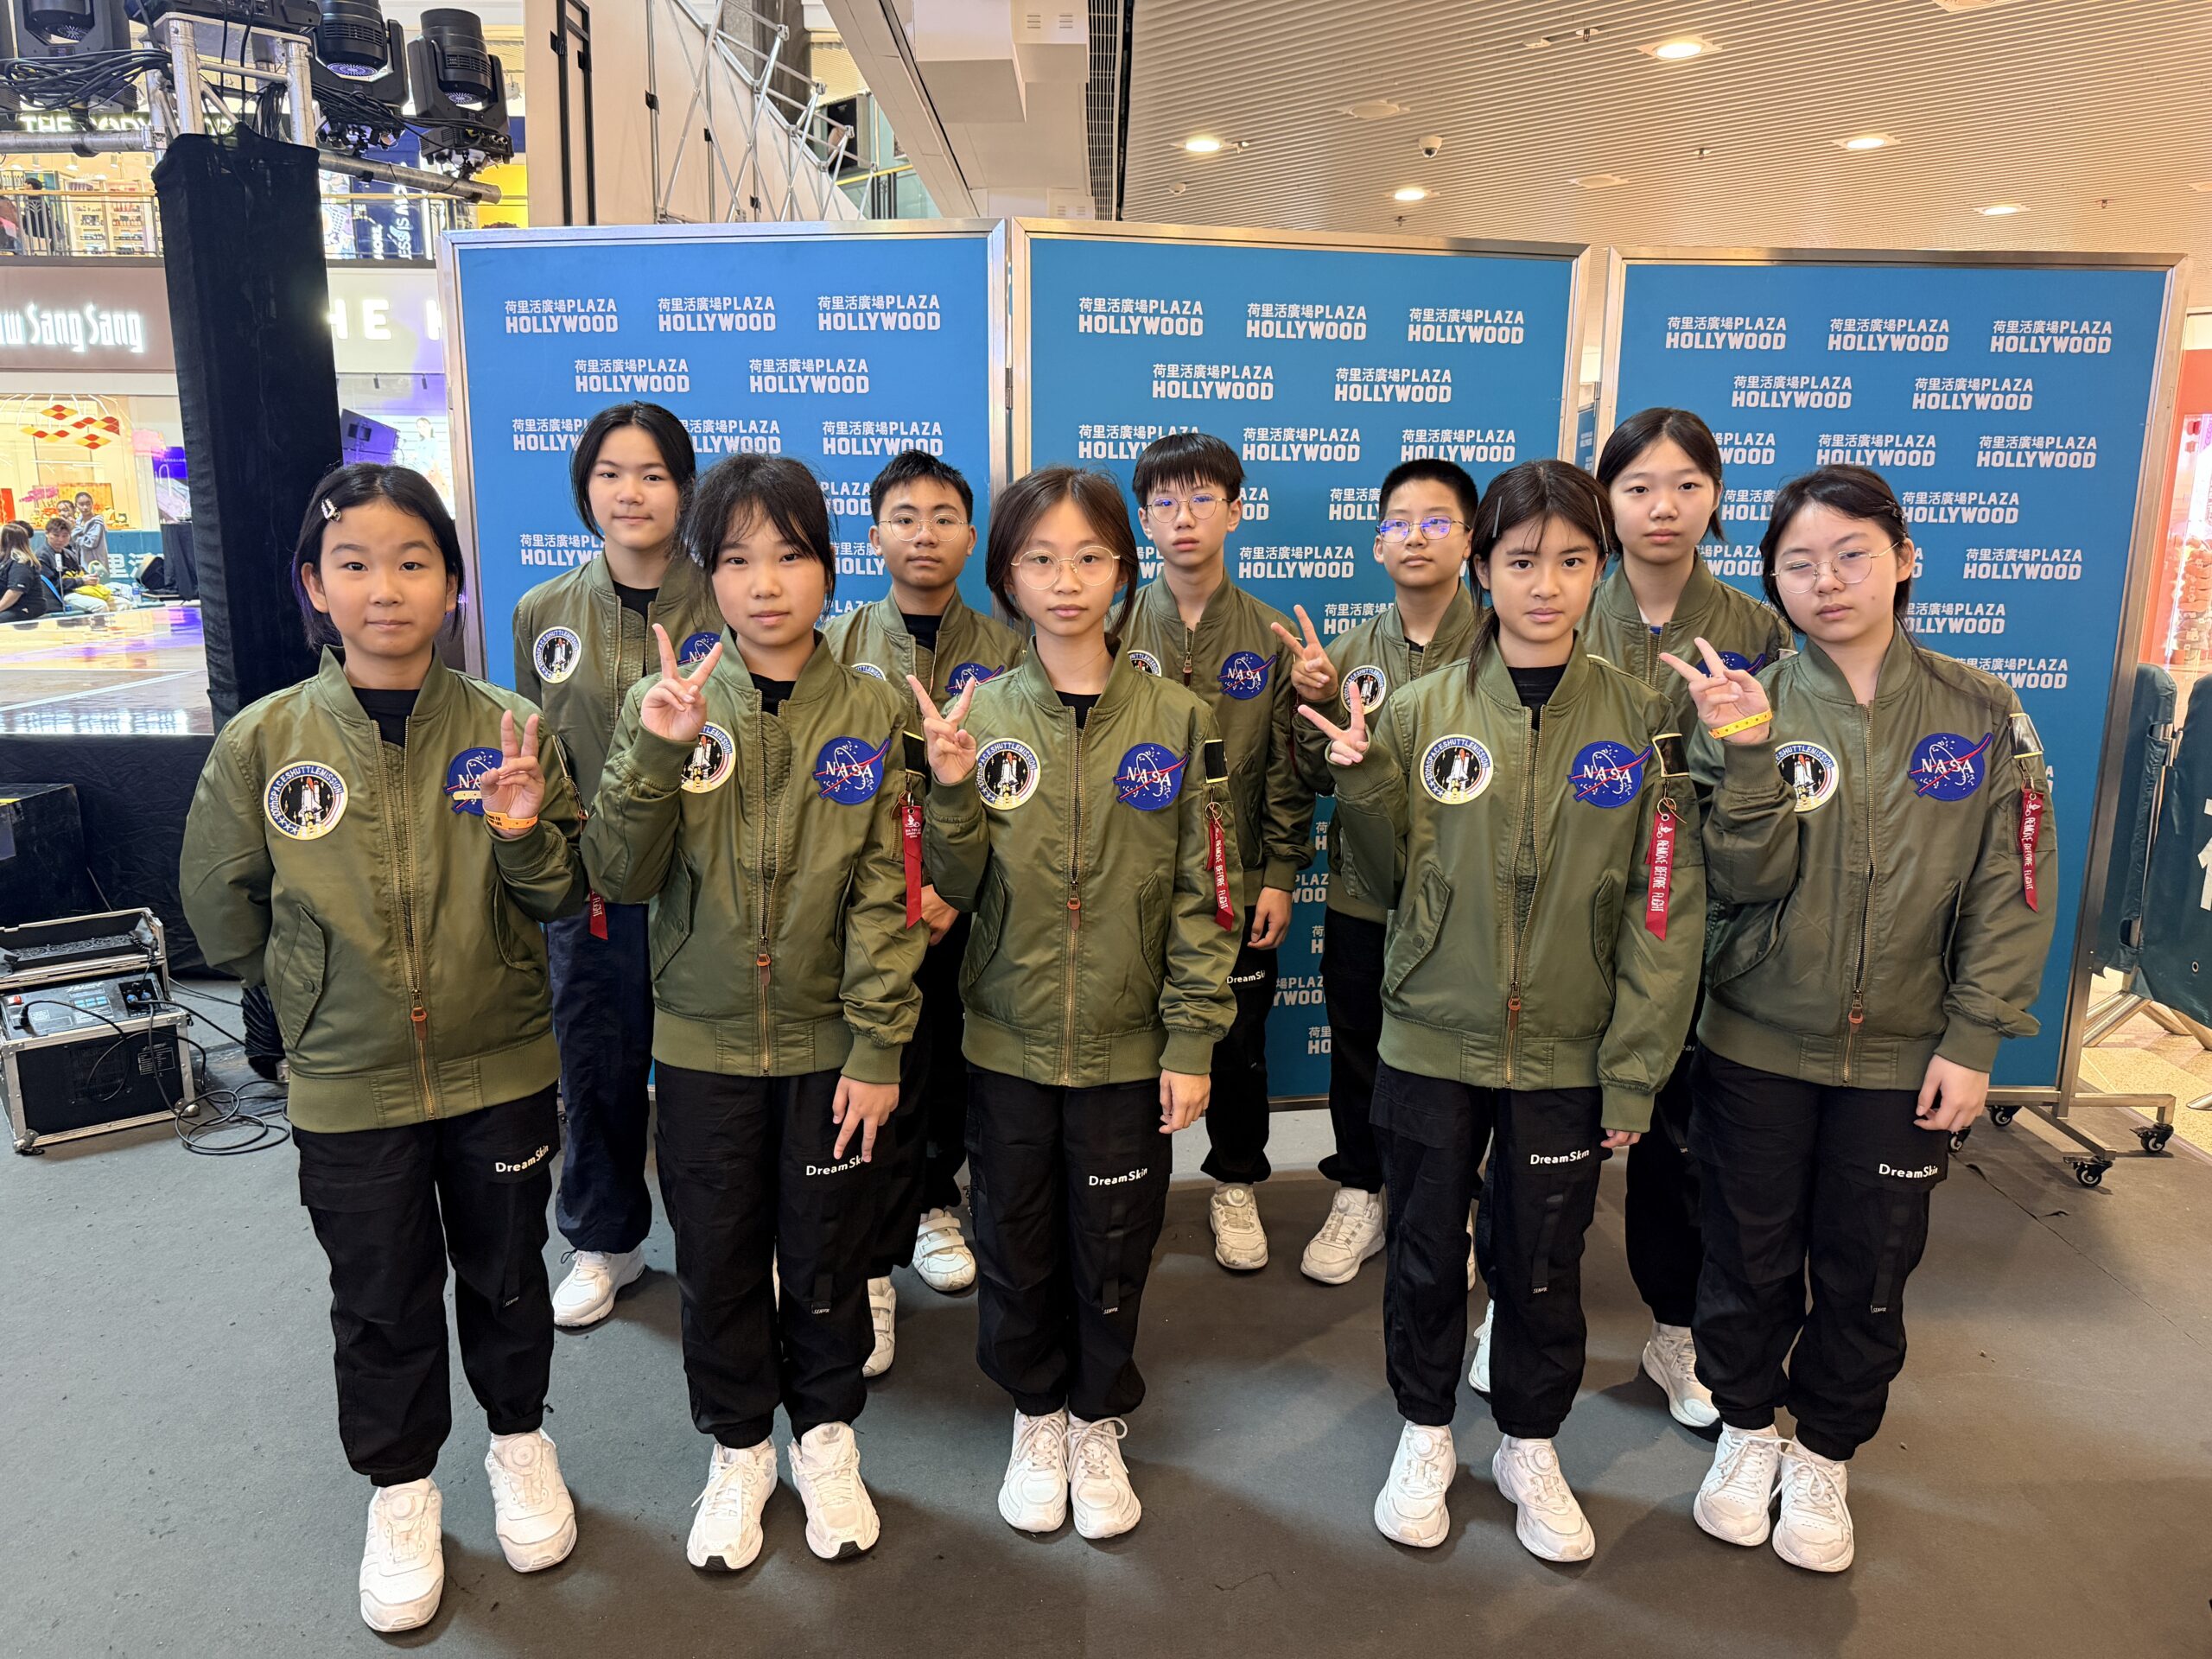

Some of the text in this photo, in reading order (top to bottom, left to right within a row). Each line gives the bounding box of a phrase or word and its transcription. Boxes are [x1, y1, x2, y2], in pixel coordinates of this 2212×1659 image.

[505, 299, 617, 314] 荷里活廣場 PLAZA
[658, 297, 775, 312] 荷里活廣場 PLAZA
[817, 295, 940, 310] 荷里活廣場 PLAZA
[1078, 297, 1203, 315] 荷里活廣場 PLAZA
[1247, 303, 1367, 320] 荷里活廣場 PLAZA
[1409, 308, 1524, 325] 荷里活廣場 PLAZA
[27, 302, 86, 352] Sang
[86, 302, 143, 353] Sang
[505, 315, 619, 334] HOLLYWOOD
[658, 314, 776, 332] HOLLYWOOD
[818, 312, 941, 331] HOLLYWOOD
[1078, 315, 1203, 336] HOLLYWOOD
[1246, 320, 1367, 340] HOLLYWOOD
[1668, 316, 1786, 331] 荷里活廣場 PLAZA
[1830, 318, 1949, 333] 荷里活廣場 PLAZA
[1993, 321, 2112, 334] 荷里活廣場 PLAZA
[1408, 324, 1524, 345] HOLLYWOOD
[1665, 332, 1786, 350] HOLLYWOOD
[1827, 334, 1949, 352] HOLLYWOOD
[1990, 335, 2112, 353] HOLLYWOOD
[575, 359, 689, 373] 荷里活廣場 PLAZA
[749, 359, 868, 373] 荷里活廣場 PLAZA
[1153, 364, 1274, 380] 荷里活廣場 PLAZA
[575, 375, 690, 392] HOLLYWOOD
[1336, 368, 1452, 383] 荷里活廣場 PLAZA
[1733, 375, 1853, 390] 荷里活廣場 PLAZA
[749, 375, 869, 394] HOLLYWOOD
[1152, 380, 1274, 400] HOLLYWOOD
[1915, 378, 2033, 391] 荷里活廣場 PLAZA
[1334, 384, 1452, 403] HOLLYWOOD
[1732, 391, 1852, 409] HOLLYWOOD
[1912, 392, 2033, 410] HOLLYWOOD
[512, 418, 574, 432] 荷里活廣場
[728, 420, 780, 434] PLAZA
[823, 421, 943, 436] 荷里活廣場 PLAZA
[1078, 424, 1146, 440] 荷里活廣場
[512, 434, 577, 452] HOLLY
[1243, 428, 1361, 442] 荷里活廣場 PLAZA
[1402, 429, 1516, 443] 荷里活廣場 PLAZA
[1724, 433, 1776, 446] PLAZA
[1818, 434, 1936, 448] 荷里活廣場 PLAZA
[1979, 435, 2097, 449] 荷里活廣場 PLAZA
[692, 435, 781, 454] LLYWOOD
[823, 437, 944, 456] HOLLYWOOD
[1078, 441, 1146, 460] HOLLY
[1242, 443, 1361, 461] HOLLYWOOD
[1401, 444, 1516, 462] HOLLYWOOD
[1815, 449, 1936, 467] HOLLYWOOD
[1976, 451, 2097, 468] HOLLYWOOD
[1240, 487, 1269, 500] AZA
[1330, 488, 1382, 502] 荷里活廣
[1724, 489, 1776, 503] 荷里活廣
[1902, 492, 2019, 505] 荷里活廣場 PLAZA
[520, 534, 581, 548] 荷里活廣場
[1239, 546, 1354, 560] 荷里活廣場 PLAZA
[1966, 548, 2082, 562] 荷里活廣場 PLAZA
[1238, 562, 1354, 579] HOLLYWOOD
[1963, 563, 2082, 581] HOLLYWOOD
[1955, 603, 2005, 616] PLAZA
[1907, 617, 2005, 634] OLLYWOOD
[2018, 658, 2068, 671] PLAZA
[1228, 668, 1262, 682] NASA
[826, 760, 874, 779] NASA
[1583, 764, 1633, 784] NASA
[1922, 758, 1975, 776] NASA
[1126, 766, 1172, 787] NASA
[1288, 976, 1324, 988] PLAZ
[495, 1145, 550, 1173] DreamSkin
[1089, 1168, 1147, 1186] DreamSkin
[1878, 1163, 1938, 1179] DreamSkin
